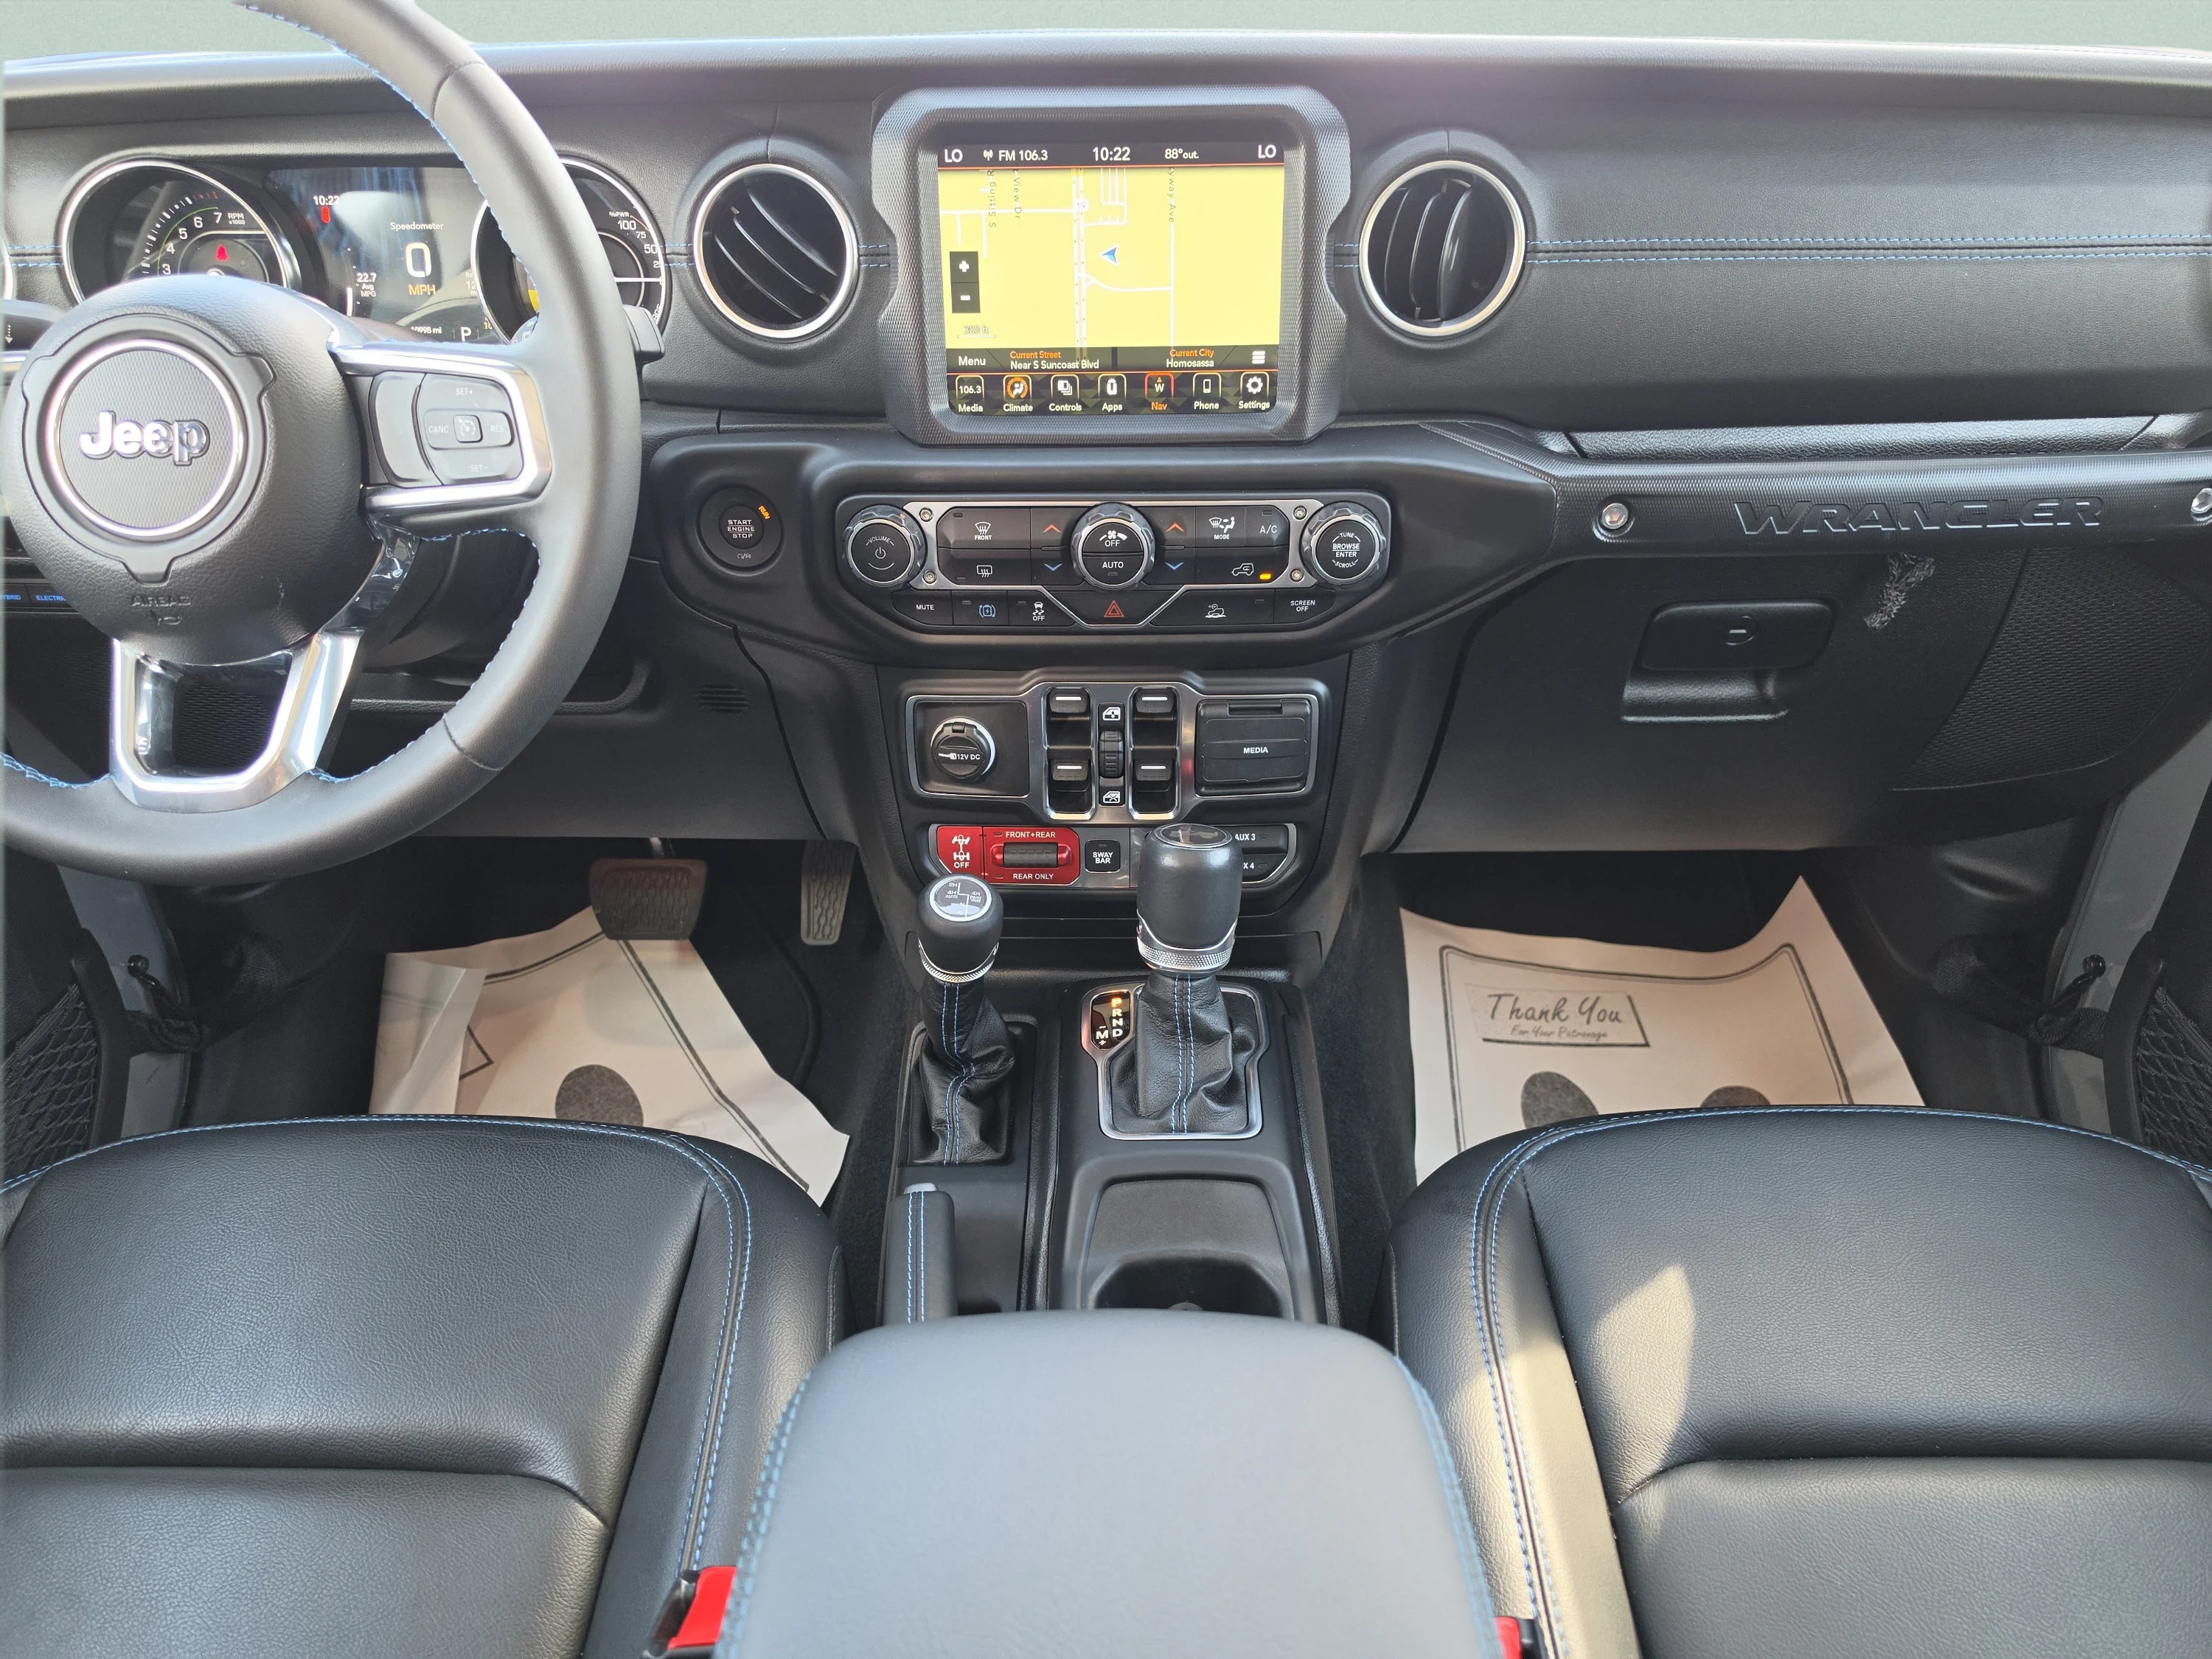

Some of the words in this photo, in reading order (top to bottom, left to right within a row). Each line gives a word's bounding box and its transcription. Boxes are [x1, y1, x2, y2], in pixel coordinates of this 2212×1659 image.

[945, 149, 963, 163] LO
[998, 150, 1016, 161] FM
[1019, 150, 1048, 161] 106.3
[1093, 147, 1131, 161] 10:22
[1258, 145, 1276, 159] LO
[1013, 177, 1021, 202] View
[313, 195, 340, 205] 10:22
[1014, 206, 1022, 219] Dr
[193, 217, 204, 229] 6
[213, 212, 222, 224] 7
[390, 222, 444, 232] Speedometer
[617, 220, 637, 231] 100
[178, 228, 188, 240] 5
[636, 231, 647, 239] 75
[166, 242, 175, 254] 4
[644, 243, 658, 254] 50
[405, 242, 432, 278] 0
[161, 263, 172, 275] 3
[356, 273, 377, 282] 22.7
[361, 283, 375, 291] Avg
[408, 284, 437, 296] MPH
[432, 326, 442, 334] mi
[460, 326, 472, 342] P
[964, 325, 981, 334] 300
[1009, 351, 1038, 359] Current
[1039, 351, 1062, 359] Street
[1169, 349, 1198, 358] Current
[1199, 348, 1214, 358] City
[959, 355, 987, 366] Menu
[1010, 361, 1032, 370] Near
[1033, 360, 1040, 369] S
[1041, 359, 1080, 369] Suncoast
[1081, 359, 1099, 369] Blvd
[1166, 358, 1215, 368] Homosassa
[959, 386, 982, 394] 106.3
[1154, 383, 1165, 393] W
[959, 403, 984, 412] Media
[1003, 403, 1034, 412] Climate
[1048, 403, 1082, 412] Controls
[1102, 402, 1124, 412] Apps
[1151, 402, 1168, 411] Nav
[1194, 400, 1220, 410] Phone
[1238, 400, 1270, 411] Settings
[428, 425, 449, 434] CANC
[490, 424, 504, 432] RES
[78, 409, 212, 467] Jeep
[758, 505, 771, 520] RUN
[1733, 495, 2104, 535] WRANGLER
[1259, 524, 1278, 534] A/C
[868, 535, 891, 544] VOLUME
[1234, 833, 1250, 841] AUX
[1251, 833, 1256, 841] 3
[1111, 998, 1122, 1008] P
[1112, 1009, 1122, 1017] R
[1488, 993, 1569, 1023] Thank
[1578, 995, 1622, 1025] You
[1112, 1018, 1124, 1027] N
[1096, 1029, 1109, 1040] M
[1112, 1028, 1123, 1037] D
[1510, 1024, 1529, 1035] For
[1531, 1025, 1556, 1037] Your
[1557, 1026, 1608, 1041] Patronage
